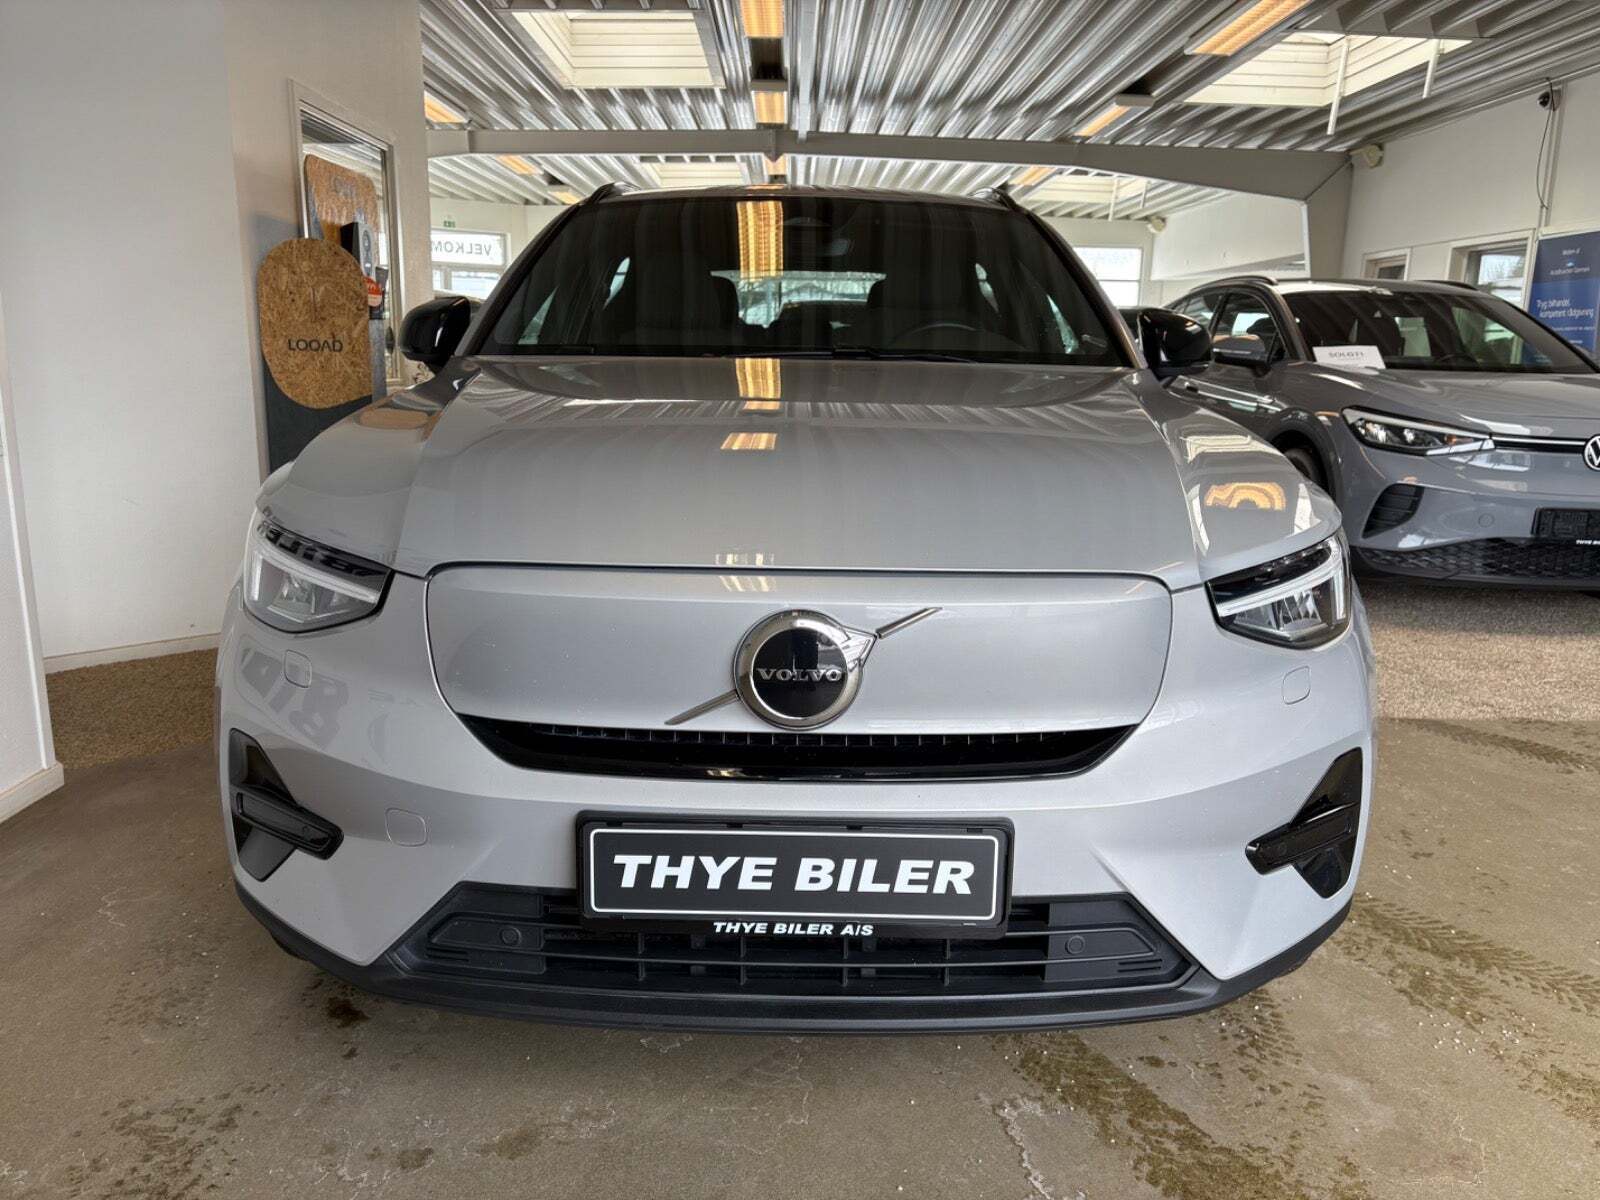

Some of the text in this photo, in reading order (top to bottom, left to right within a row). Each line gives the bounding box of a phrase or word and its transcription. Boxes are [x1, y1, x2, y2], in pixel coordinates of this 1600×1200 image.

[756, 667, 843, 682] VOLVO
[613, 854, 975, 895] THYE BILER
[713, 921, 874, 937] THYE BILER A/S
